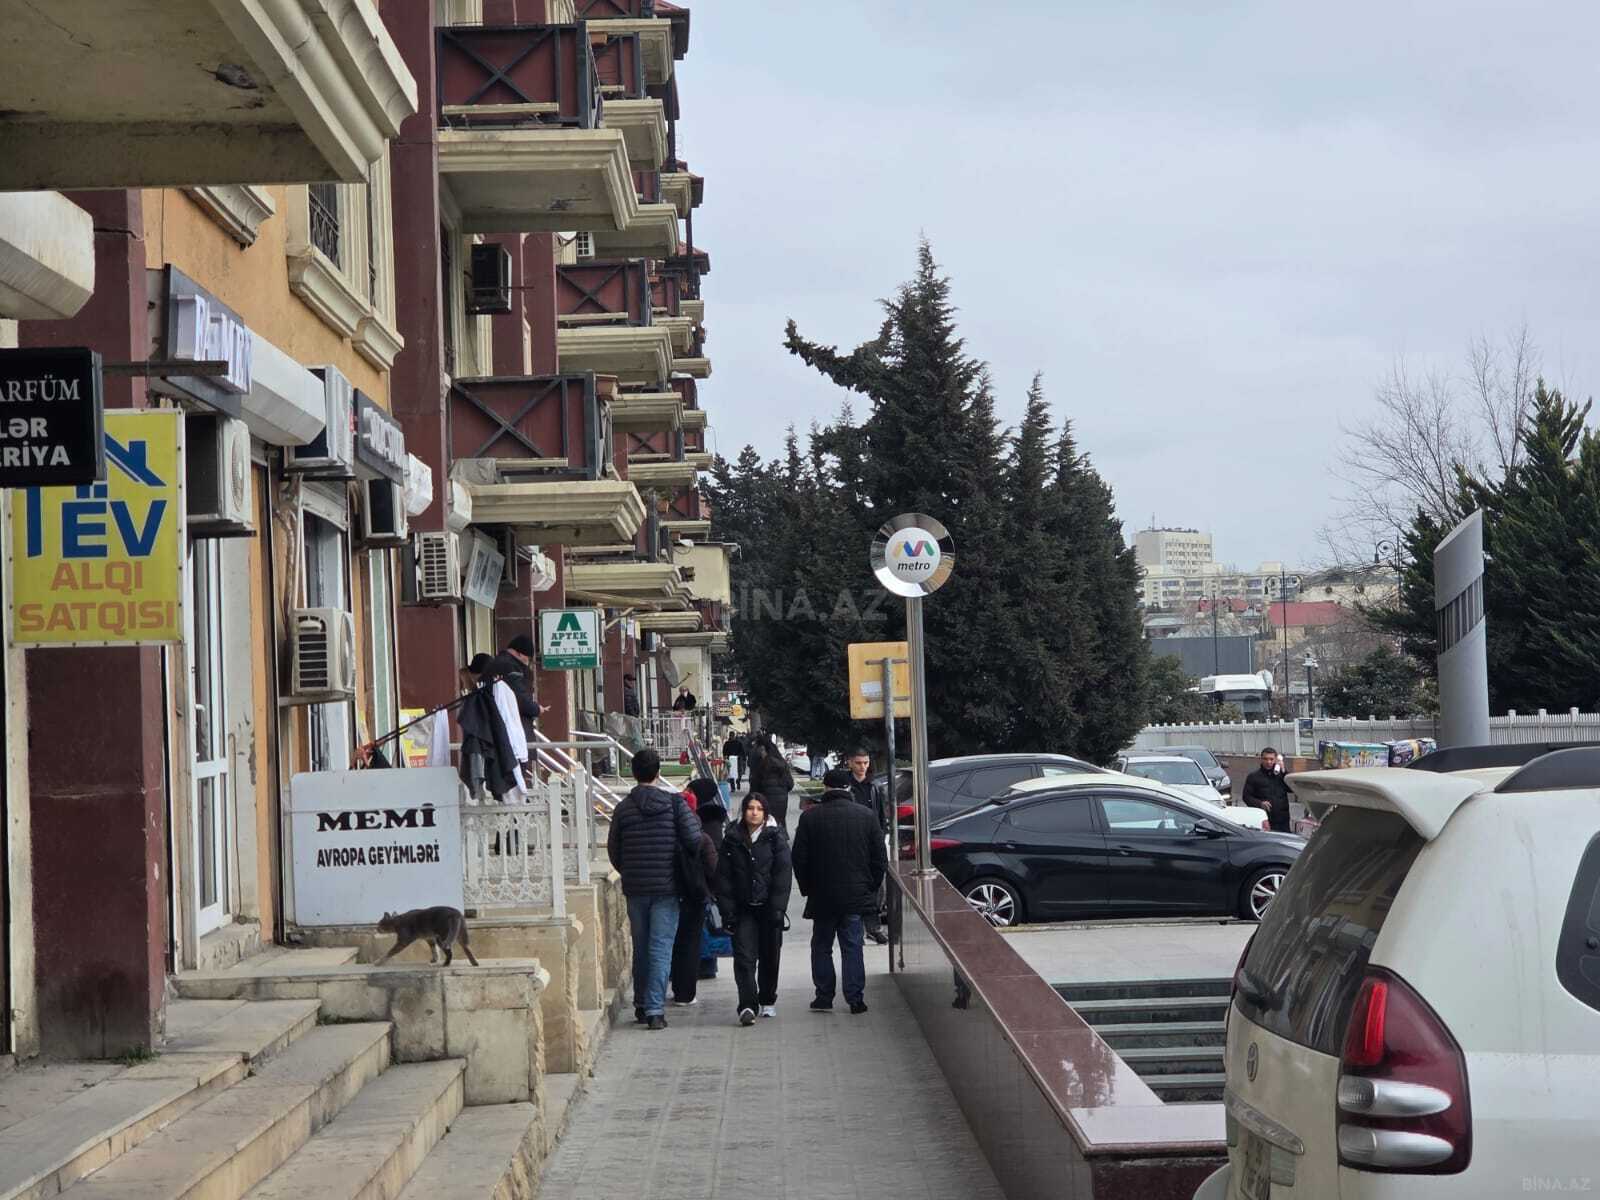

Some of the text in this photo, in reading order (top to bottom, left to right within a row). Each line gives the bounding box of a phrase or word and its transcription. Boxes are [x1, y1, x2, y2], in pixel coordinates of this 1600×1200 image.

[0, 441, 71, 467] RİYA
[51, 561, 143, 595] ALQI
[897, 561, 930, 571] metro
[19, 602, 175, 636] SATQISI
[551, 632, 588, 640] APTEK
[316, 803, 437, 832] MEMİ
[316, 840, 440, 868] AVROPA GEYİMLƏRİ
